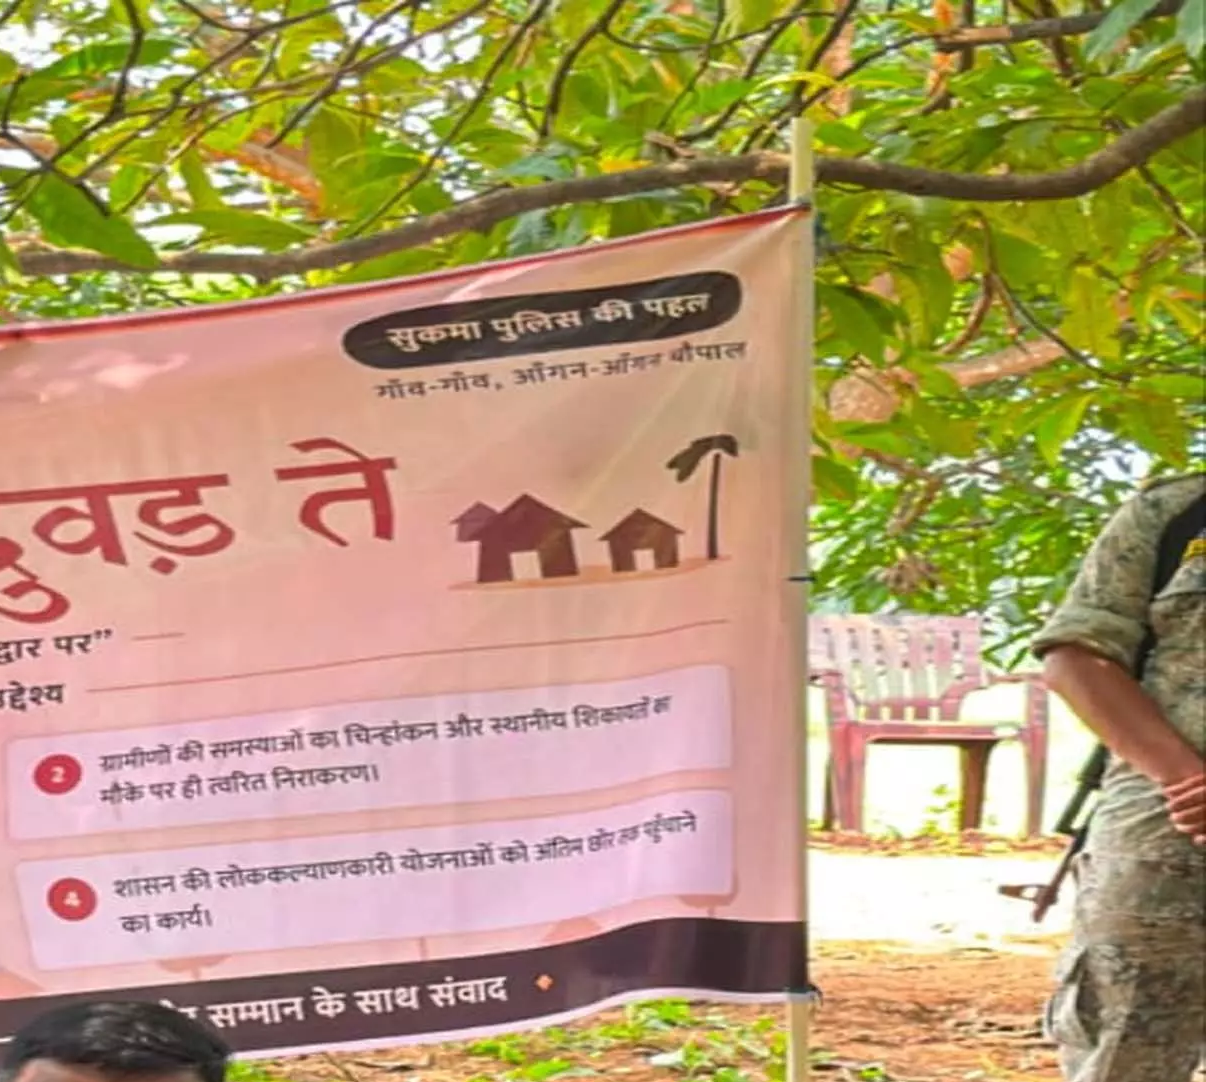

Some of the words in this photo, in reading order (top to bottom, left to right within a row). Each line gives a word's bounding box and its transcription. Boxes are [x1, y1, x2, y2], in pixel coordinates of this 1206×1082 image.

[385, 320, 483, 353] सुकमा
[491, 308, 583, 343] पुलिस
[590, 299, 634, 326] की
[640, 291, 712, 318] पहल
[275, 437, 398, 549] ते
[98, 743, 172, 772] ग्रामीणों
[177, 740, 205, 763] की
[308, 730, 339, 750] का
[444, 713, 485, 739] और
[489, 708, 569, 736] स्थानीय
[98, 780, 145, 804] मौके
[149, 783, 176, 800] पर
[180, 773, 205, 798] ही
[207, 770, 268, 796] त्वरित
[113, 876, 178, 898] शासन
[182, 867, 214, 892] की
[215, 851, 396, 889] लोककल्याणकारी
[399, 842, 496, 872] योजनाओं
[499, 840, 530, 865] को
[119, 913, 152, 934] का
[206, 999, 304, 1030] सम्मान
[312, 986, 352, 1021] के
[356, 985, 421, 1016] साथ
[428, 974, 510, 1005] संवाद
